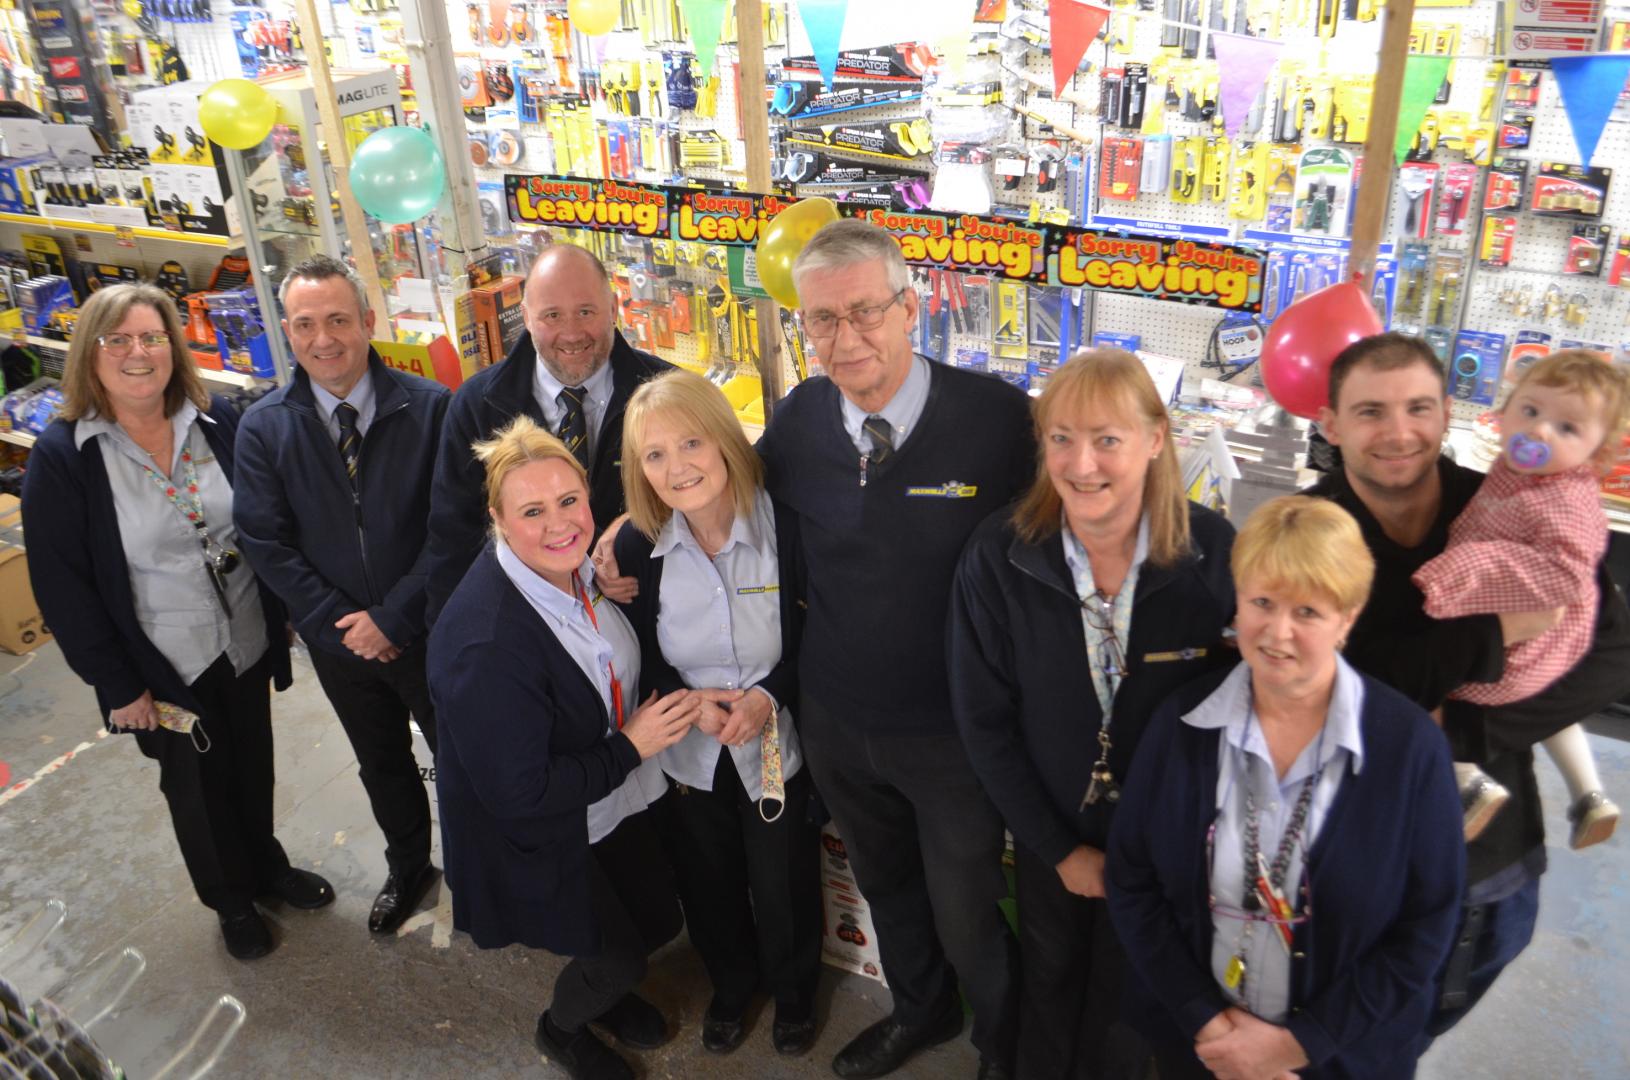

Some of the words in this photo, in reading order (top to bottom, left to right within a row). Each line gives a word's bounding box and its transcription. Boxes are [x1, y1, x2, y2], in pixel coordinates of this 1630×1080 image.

[837, 58, 889, 71] PREDATOR
[810, 93, 860, 108] PREDATOR
[836, 133, 884, 148] PREDATOR
[530, 176, 590, 200] Sorry
[603, 180, 665, 206] You're
[822, 171, 864, 179] PREDATOR
[516, 187, 658, 235] Leaving
[694, 193, 750, 218] Sorry
[680, 204, 769, 241] Leavi
[871, 209, 944, 237] Sorry
[961, 214, 1041, 247] You're
[899, 229, 1032, 277] aving
[1081, 233, 1157, 264] Sorry
[1175, 240, 1259, 275] You're
[1059, 246, 1248, 307] Leaving
